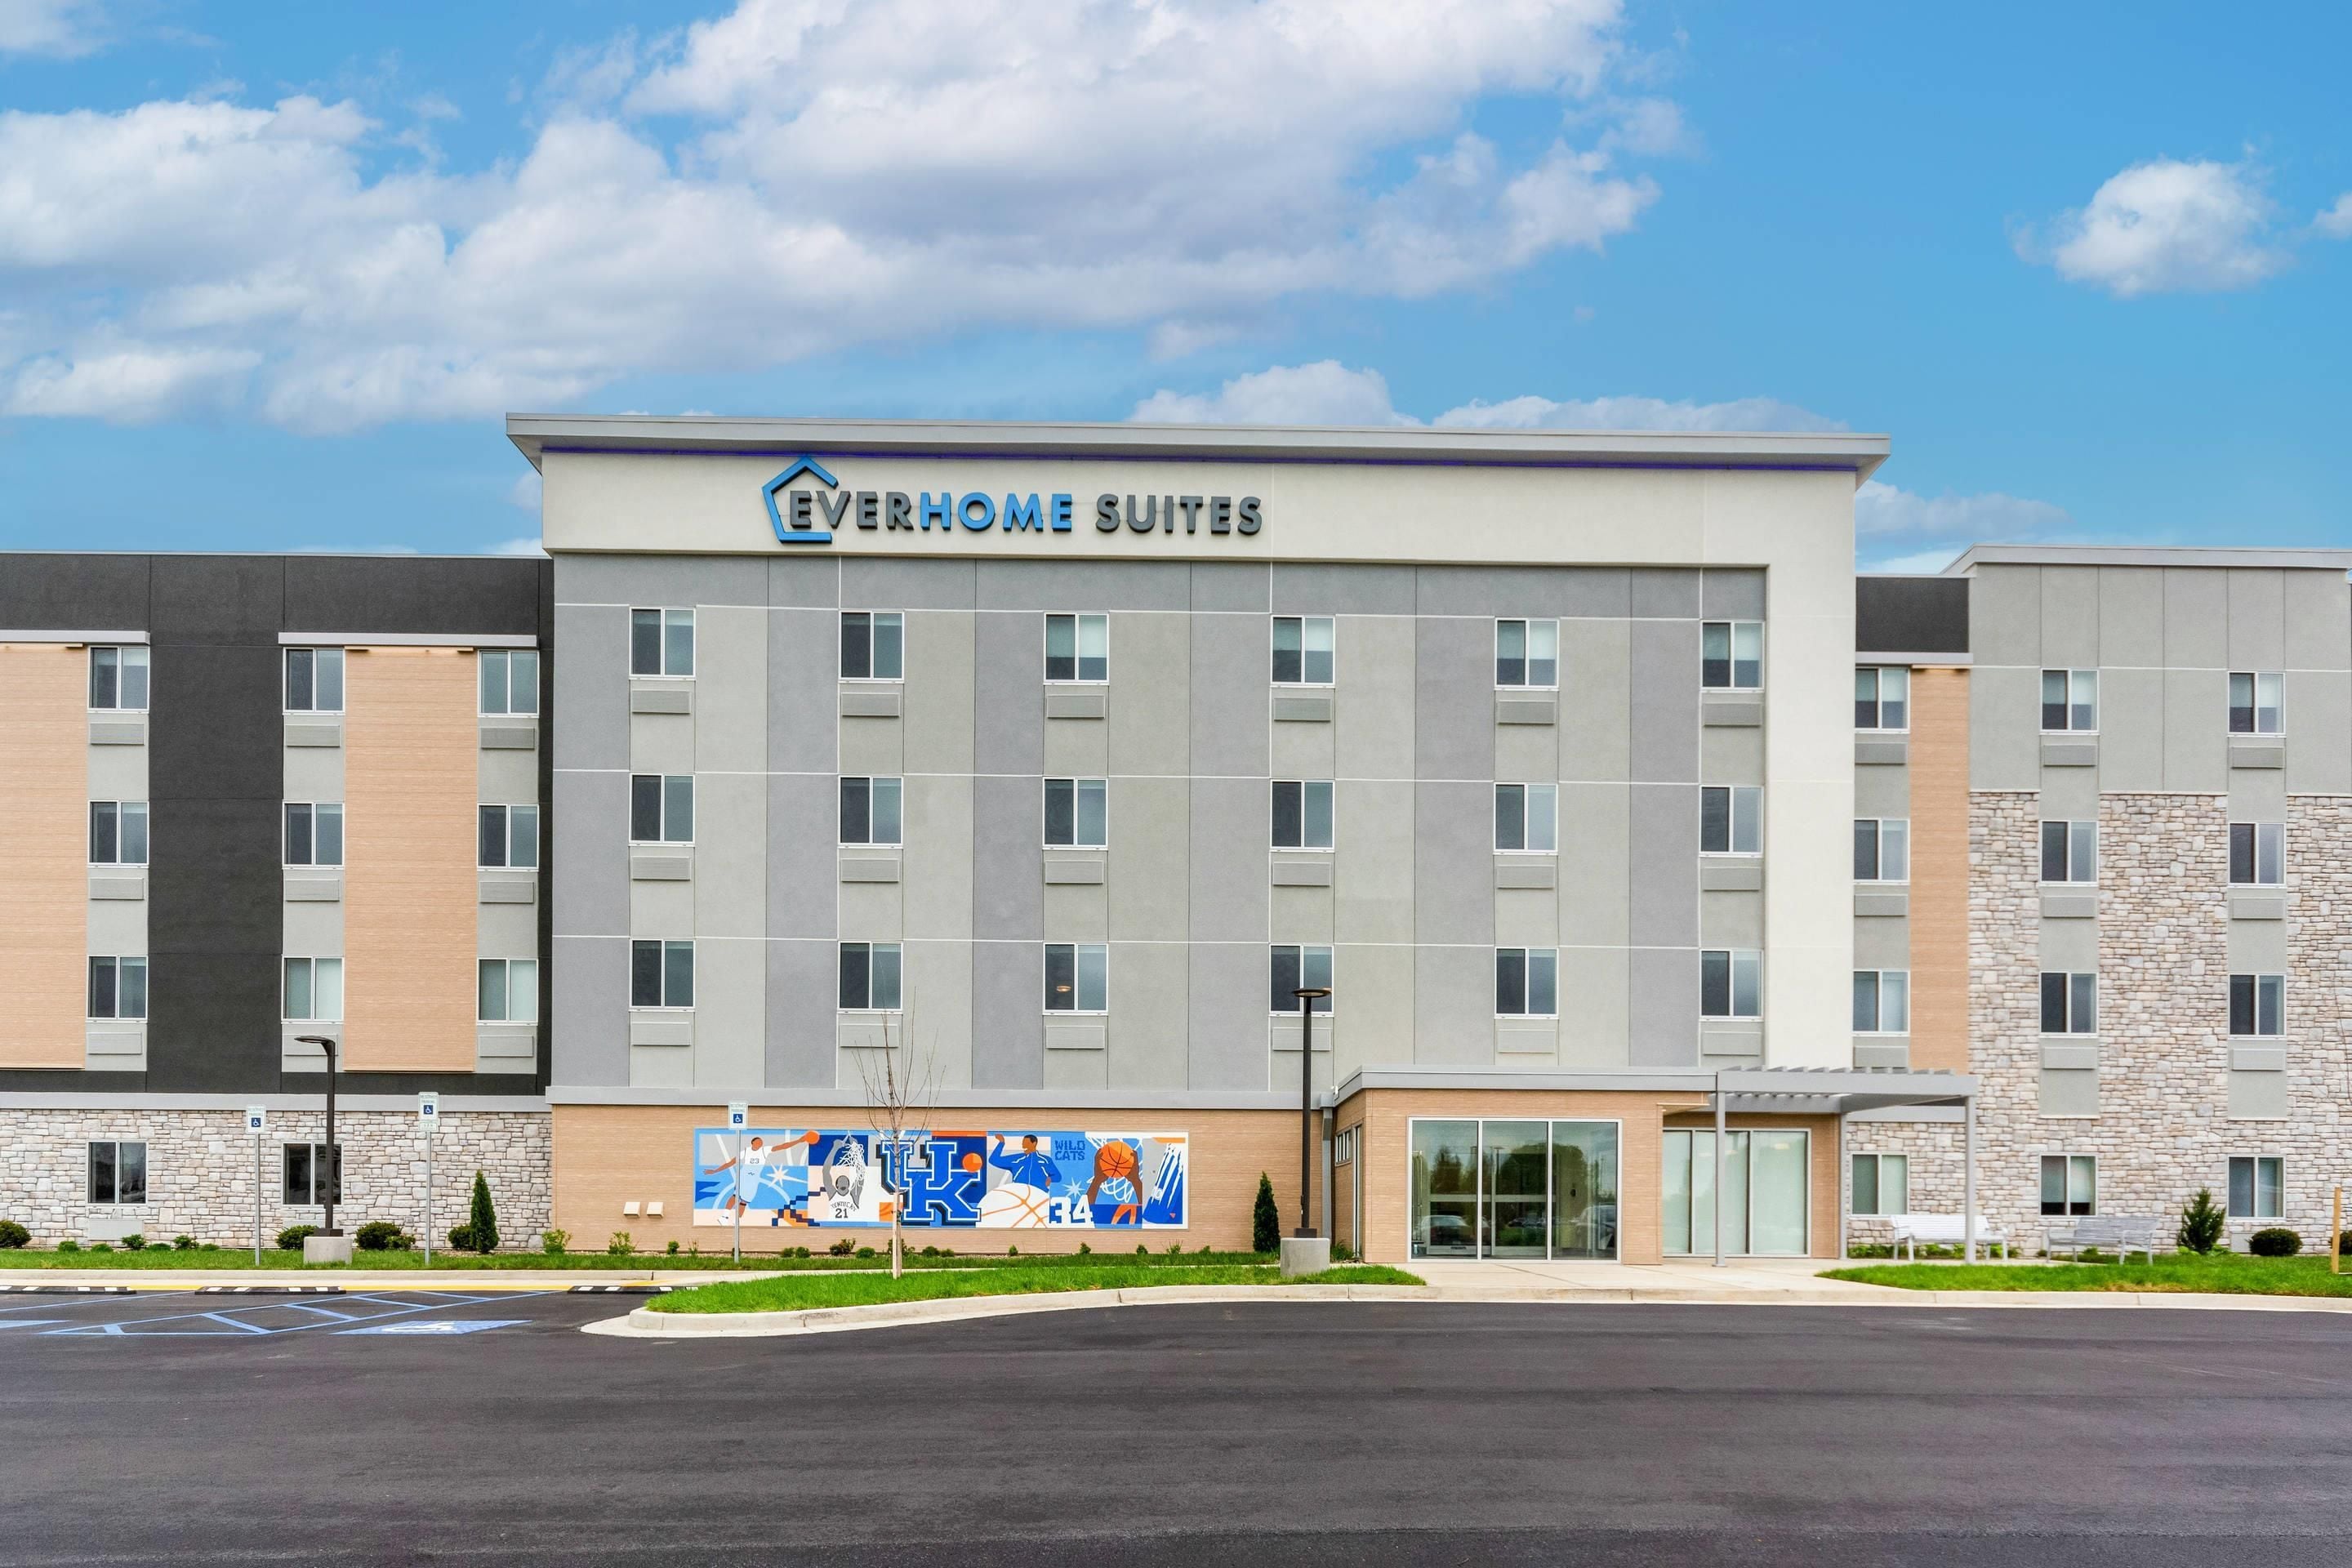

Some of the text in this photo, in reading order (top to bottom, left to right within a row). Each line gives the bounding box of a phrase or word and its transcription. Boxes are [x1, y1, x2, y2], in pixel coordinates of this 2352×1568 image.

[790, 490, 1263, 535] EVERHOME SUITES
[1054, 1140, 1085, 1151] WILD
[1054, 1151, 1085, 1160] CATS
[835, 1208, 849, 1218] 21
[1049, 1195, 1094, 1227] 34
